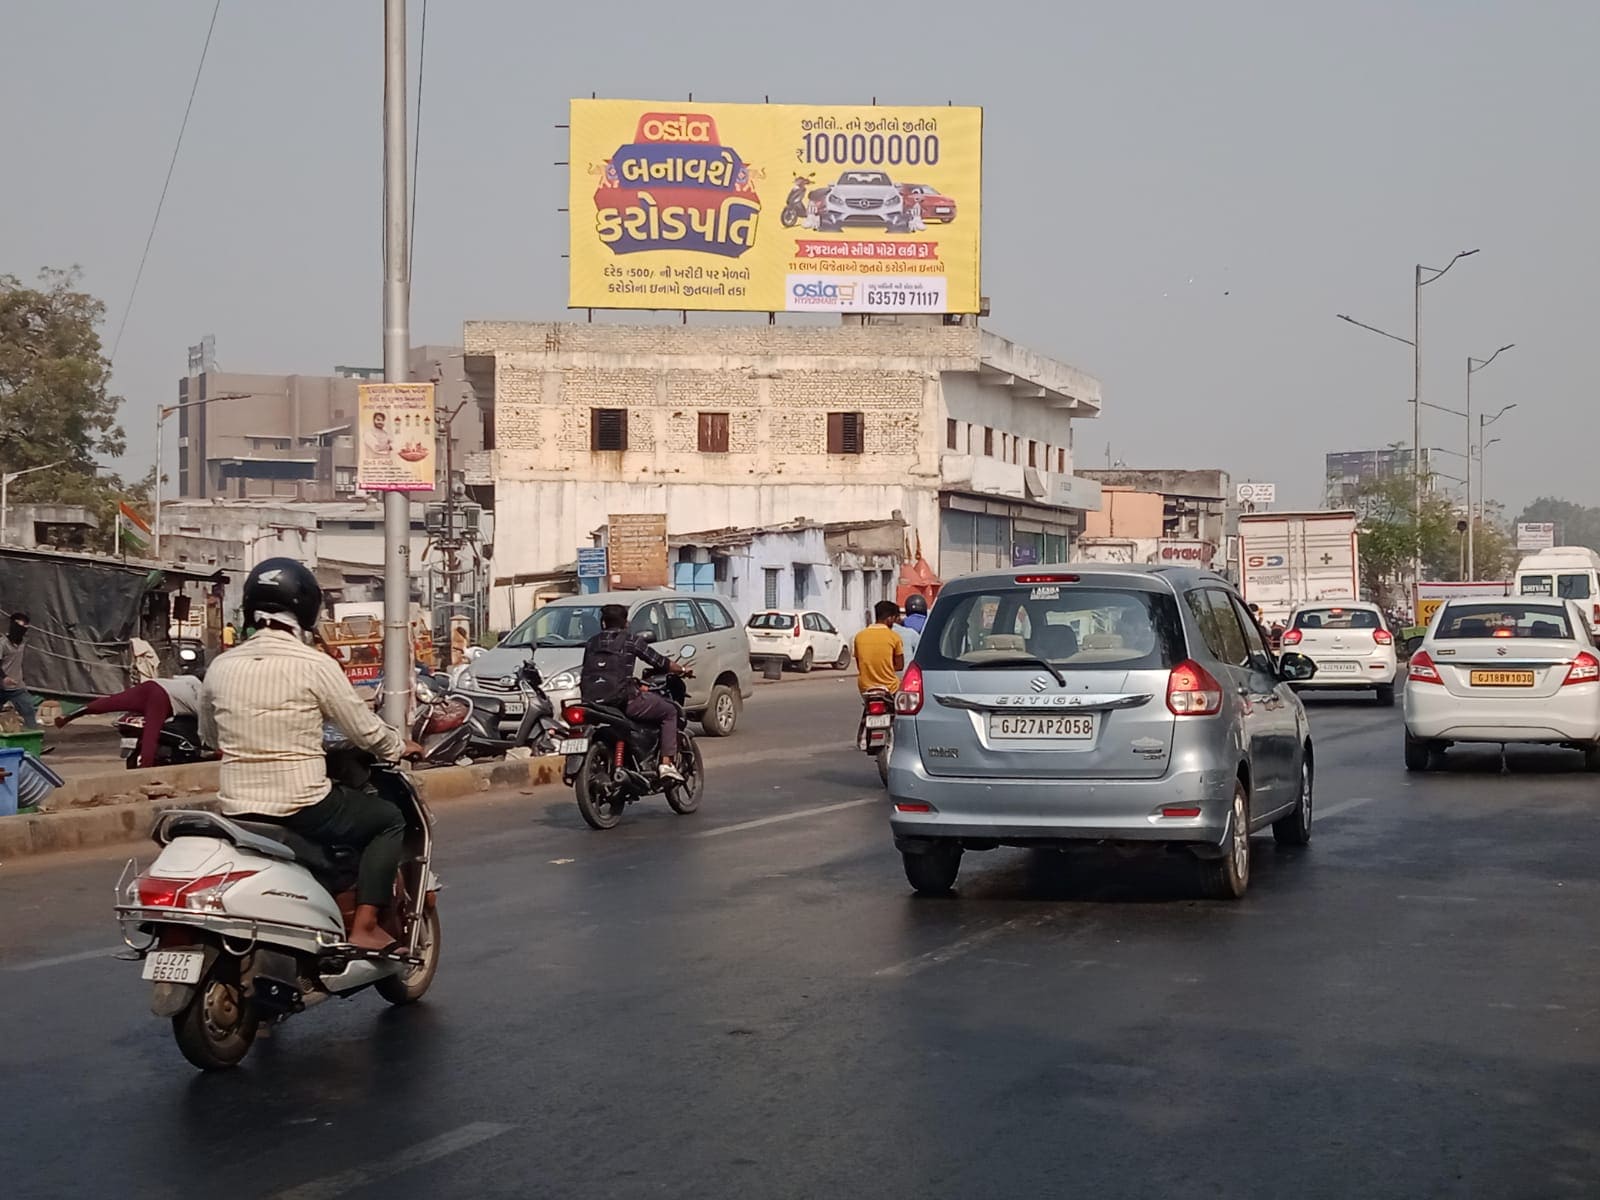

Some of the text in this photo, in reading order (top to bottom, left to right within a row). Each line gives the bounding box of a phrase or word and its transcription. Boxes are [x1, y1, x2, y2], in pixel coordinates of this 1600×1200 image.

[643, 116, 710, 142] osia
[846, 117, 861, 130] તમે
[864, 117, 899, 132] જીતીલો
[902, 118, 937, 133] જીતીલો
[621, 152, 734, 187] બનાવશે
[597, 191, 761, 247] કરોડપતિ
[805, 244, 849, 258] ગુજરાતનો
[604, 264, 623, 277] દરેક
[706, 269, 720, 280] પર
[608, 280, 646, 294] કરોડોના
[793, 280, 838, 297] osia
[868, 291, 939, 306] 63579 71117
[995, 696, 1082, 705] ERTIGA
[1002, 719, 1091, 734] GJ27AP2058
[156, 953, 192, 966] GJ27F
